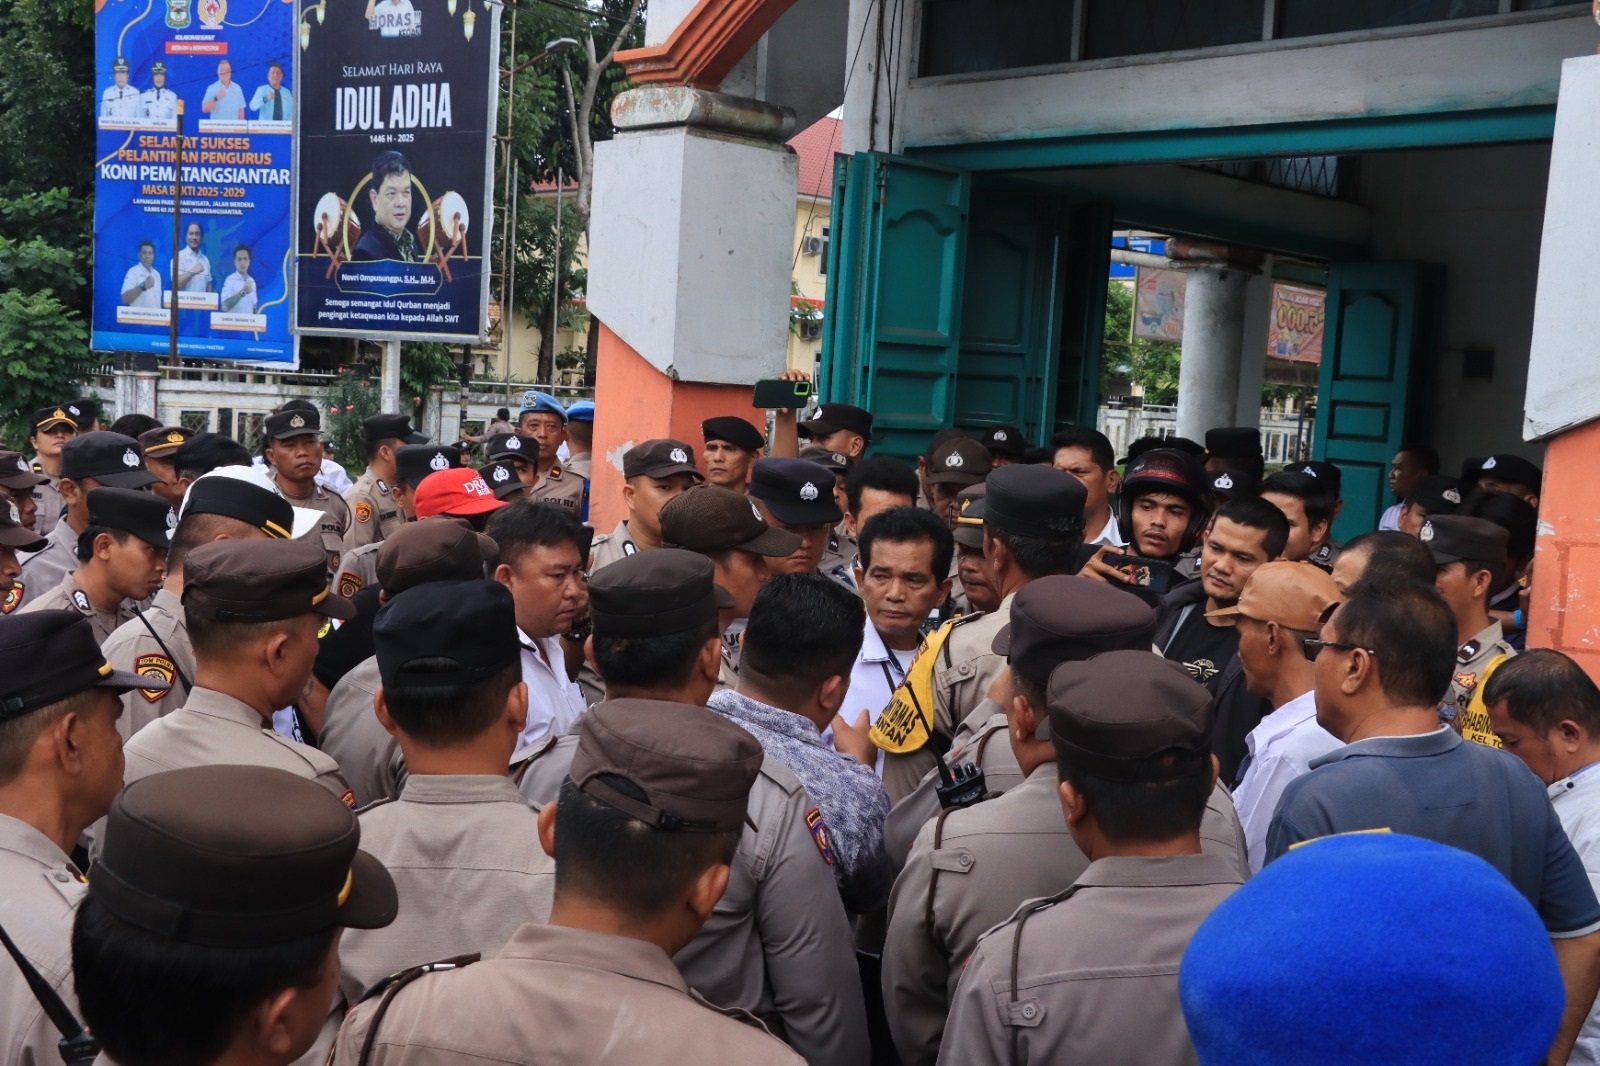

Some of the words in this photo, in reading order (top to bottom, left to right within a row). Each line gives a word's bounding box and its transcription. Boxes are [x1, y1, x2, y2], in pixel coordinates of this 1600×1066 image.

[389, 62, 414, 75] HARI
[417, 61, 443, 74] RAYA
[336, 85, 384, 131] IDUL
[389, 82, 452, 129] ADHA
[200, 136, 250, 150] SUKSES
[369, 134, 386, 143] 1446
[386, 134, 393, 142] H
[397, 133, 415, 142] 2025
[200, 151, 272, 165] PENGURUS
[101, 164, 137, 181] KONI
[142, 184, 168, 195] MASA
[169, 185, 195, 196] BKTI
[197, 186, 218, 197] 2025
[342, 273, 359, 281] Novri
[359, 274, 403, 284] Ompusunggu,
[325, 298, 350, 309] Semoga
[351, 300, 382, 309] semangat
[383, 300, 396, 308] Idul
[397, 300, 422, 310] Qurban
[423, 301, 451, 312] menjadi
[318, 310, 349, 321] pengingat
[350, 310, 385, 322] ketaqwaan
[387, 312, 400, 320] kita
[400, 312, 425, 323] kepada
[426, 313, 443, 322] Allah
[444, 314, 460, 323] SWT
[1470, 733, 1491, 745] KEL.
[1492, 738, 1504, 750] TO
